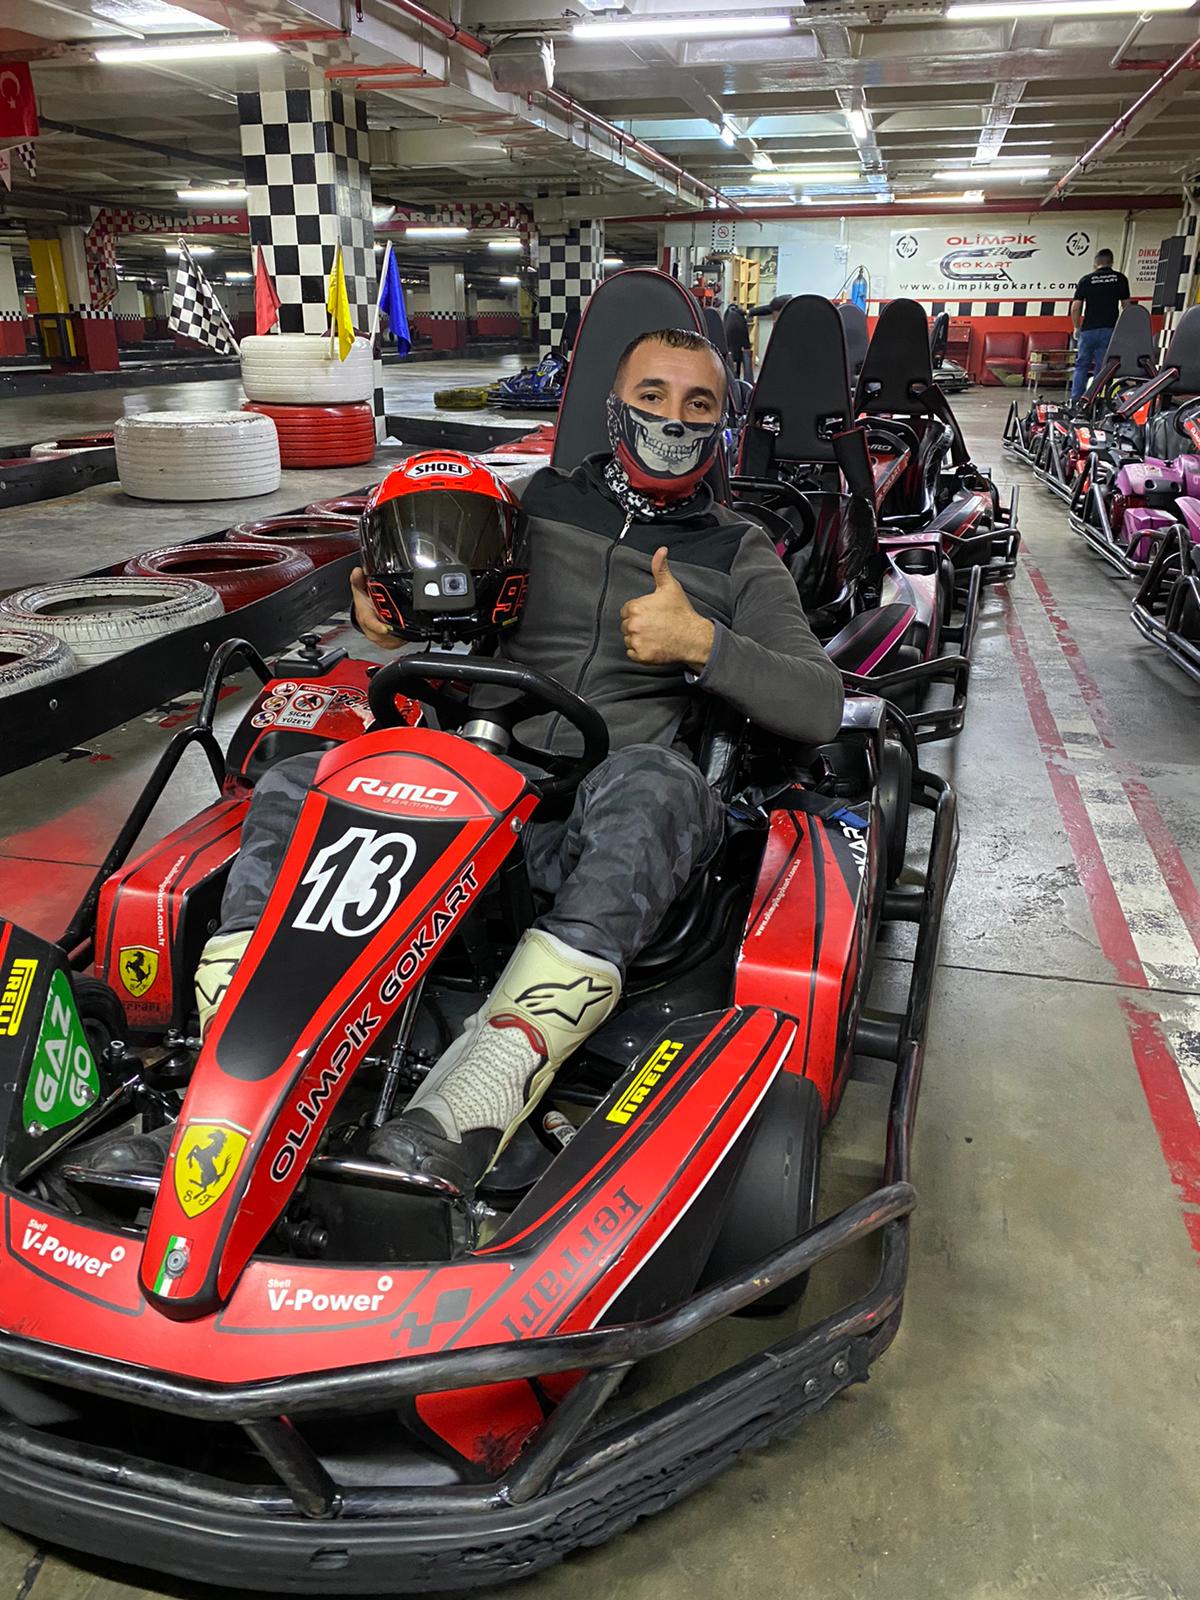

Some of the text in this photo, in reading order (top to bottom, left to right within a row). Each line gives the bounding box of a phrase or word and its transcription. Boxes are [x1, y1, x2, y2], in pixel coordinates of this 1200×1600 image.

[953, 261, 1012, 269] GO KART
[414, 462, 464, 475] SHOEI
[382, 797, 448, 813] GERMANY
[291, 826, 417, 938] 13
[378, 860, 479, 1005] GOKART
[34, 995, 72, 1112] GAZ
[69, 1045, 91, 1107] GO
[605, 1039, 684, 1125] PIRELLI
[27, 1218, 49, 1232] Shell
[21, 1228, 113, 1278] V-Power
[501, 1184, 643, 1340] Ferrari
[267, 1277, 292, 1288] Shell
[267, 1288, 385, 1312] V-Power
